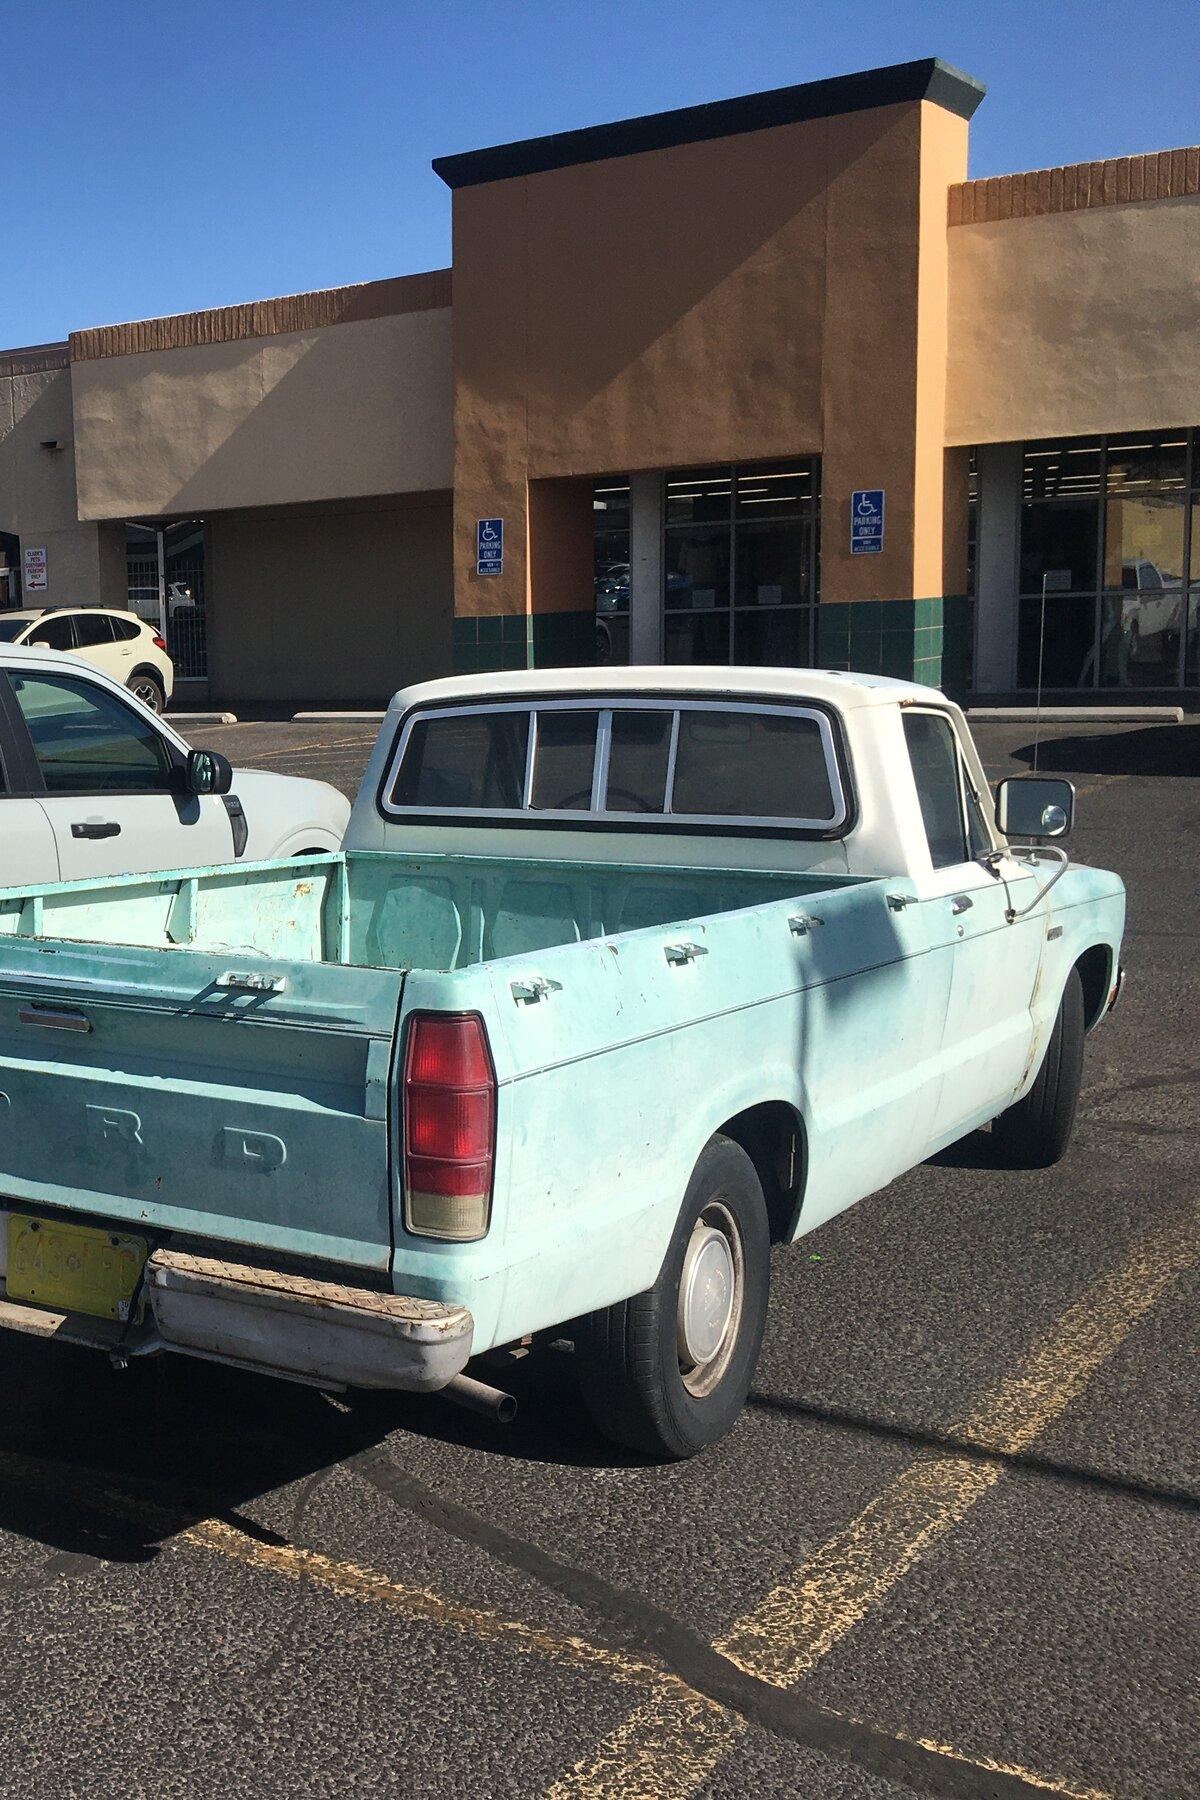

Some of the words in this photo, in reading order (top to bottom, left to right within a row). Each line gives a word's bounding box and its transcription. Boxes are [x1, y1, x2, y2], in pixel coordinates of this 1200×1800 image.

[854, 516, 881, 526] PARKING
[859, 527, 875, 536] ONLY
[480, 541, 500, 550] PARKING
